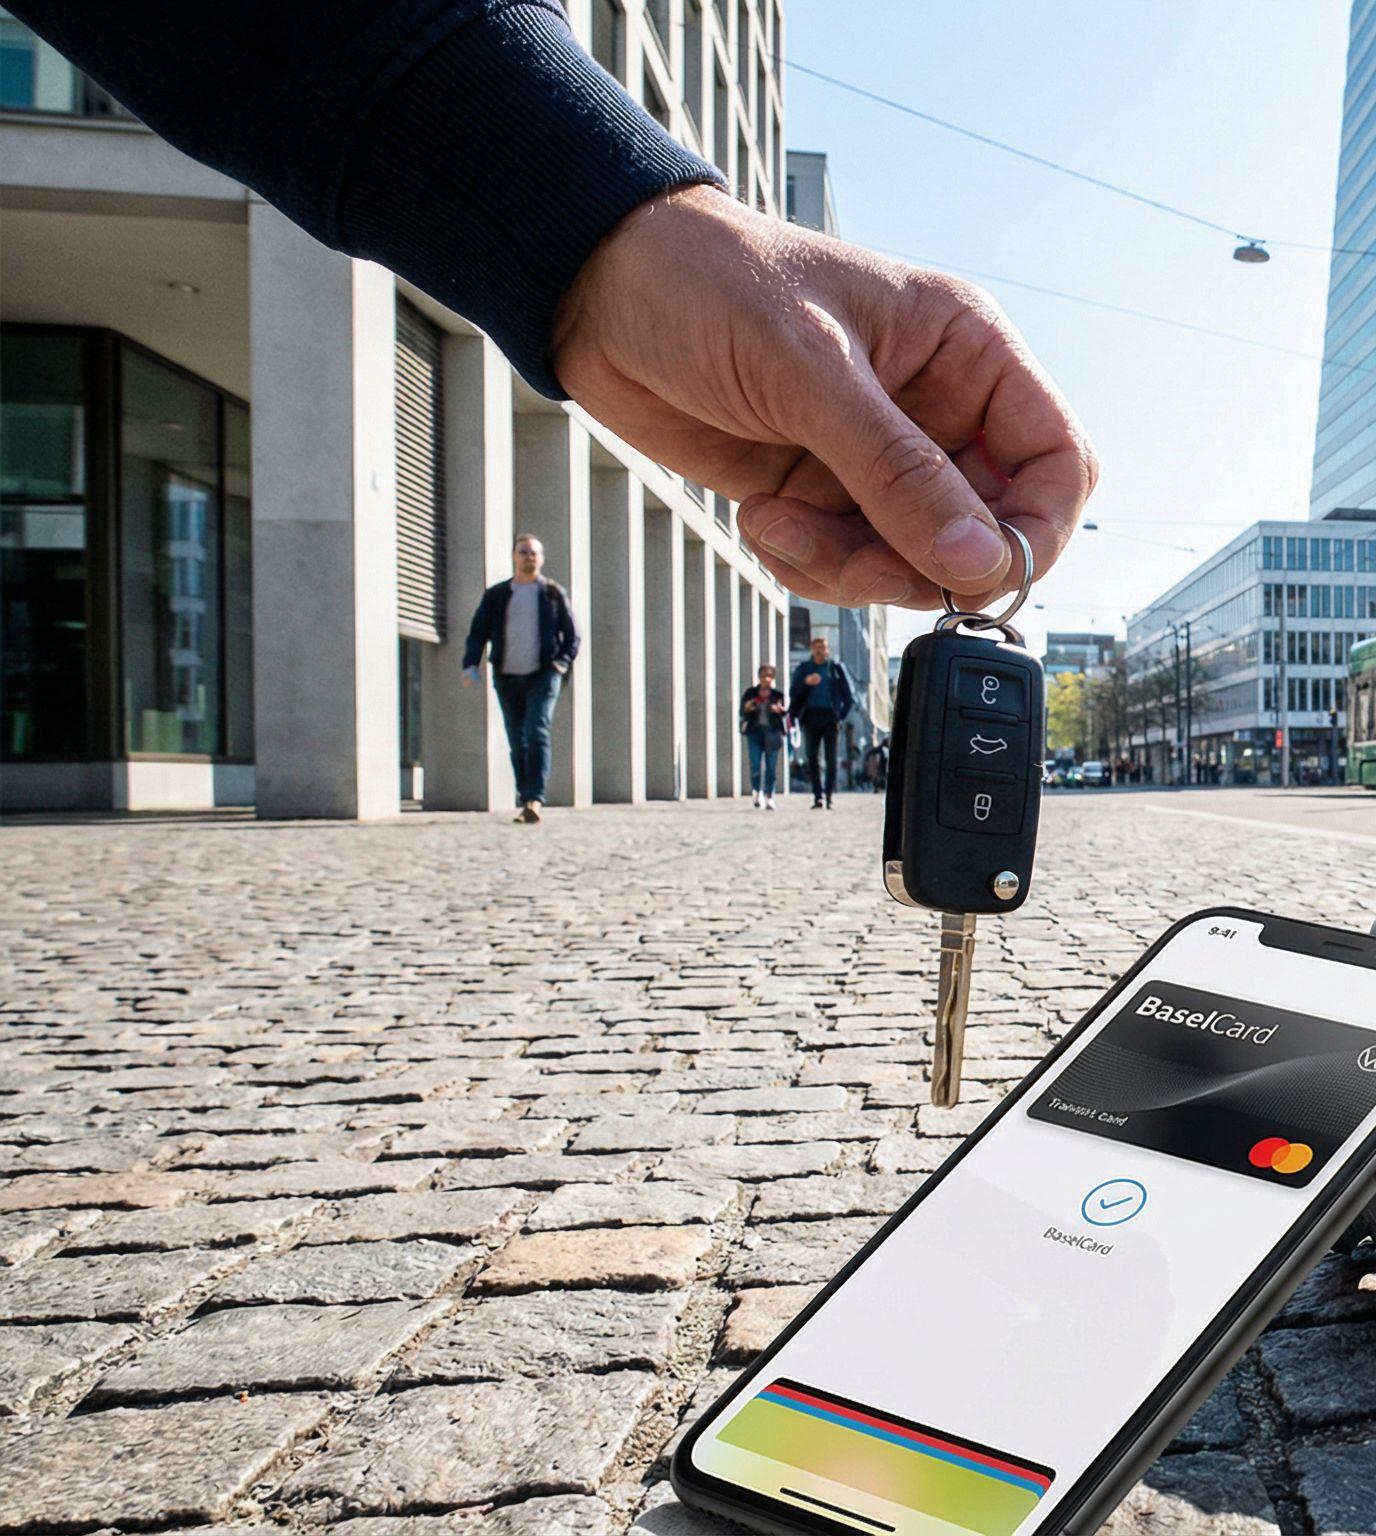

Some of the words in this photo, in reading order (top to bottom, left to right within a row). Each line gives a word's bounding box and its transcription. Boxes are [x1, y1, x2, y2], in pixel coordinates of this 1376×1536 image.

[1207, 926, 1238, 940] 9:41
[1134, 996, 1280, 1045] BaselCard
[1043, 1226, 1114, 1256] BaselCard
